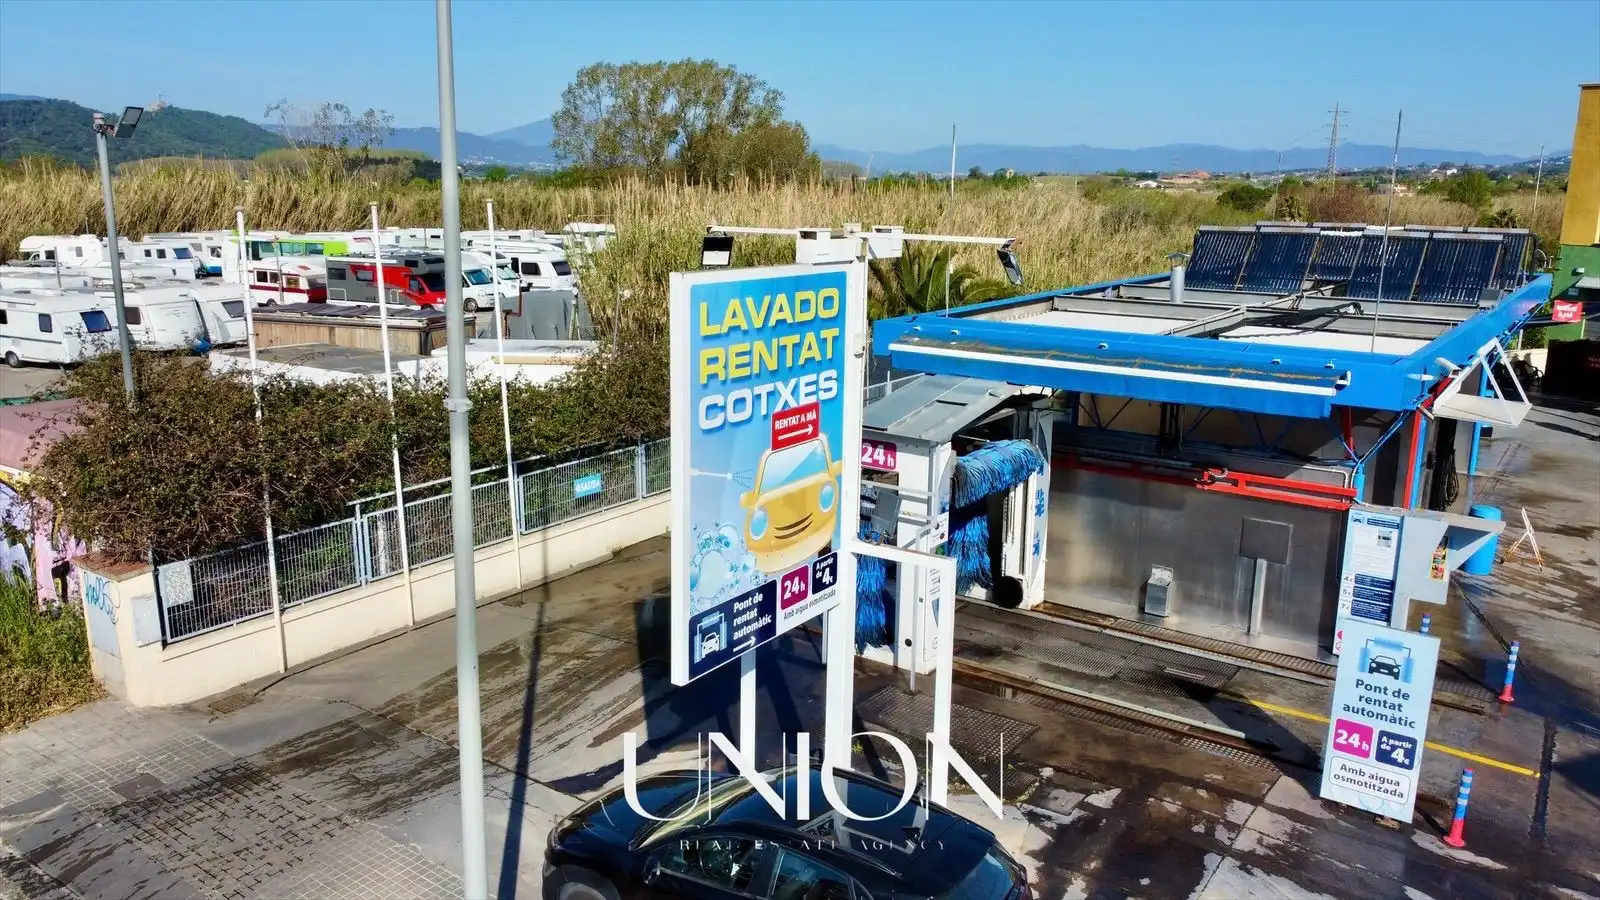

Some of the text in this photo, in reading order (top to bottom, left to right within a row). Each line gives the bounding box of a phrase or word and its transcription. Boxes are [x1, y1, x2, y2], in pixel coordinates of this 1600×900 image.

[700, 287, 839, 337] LAVADO
[700, 328, 839, 384] RENTAT
[699, 369, 838, 430] COTXES
[775, 414, 800, 430] RENTAT
[800, 413, 805, 424] A
[733, 592, 763, 613] Pont de
[733, 607, 758, 627] rentat
[733, 613, 772, 640] automàtic
[1355, 678, 1411, 701] Pont de
[1358, 694, 1404, 712] rentat
[1342, 703, 1416, 729] automàtic
[1380, 743, 1391, 751] de
[1388, 738, 1412, 749] partir
[1333, 773, 1405, 799] osmotitzada
[1339, 763, 1401, 787] Amb aigua
